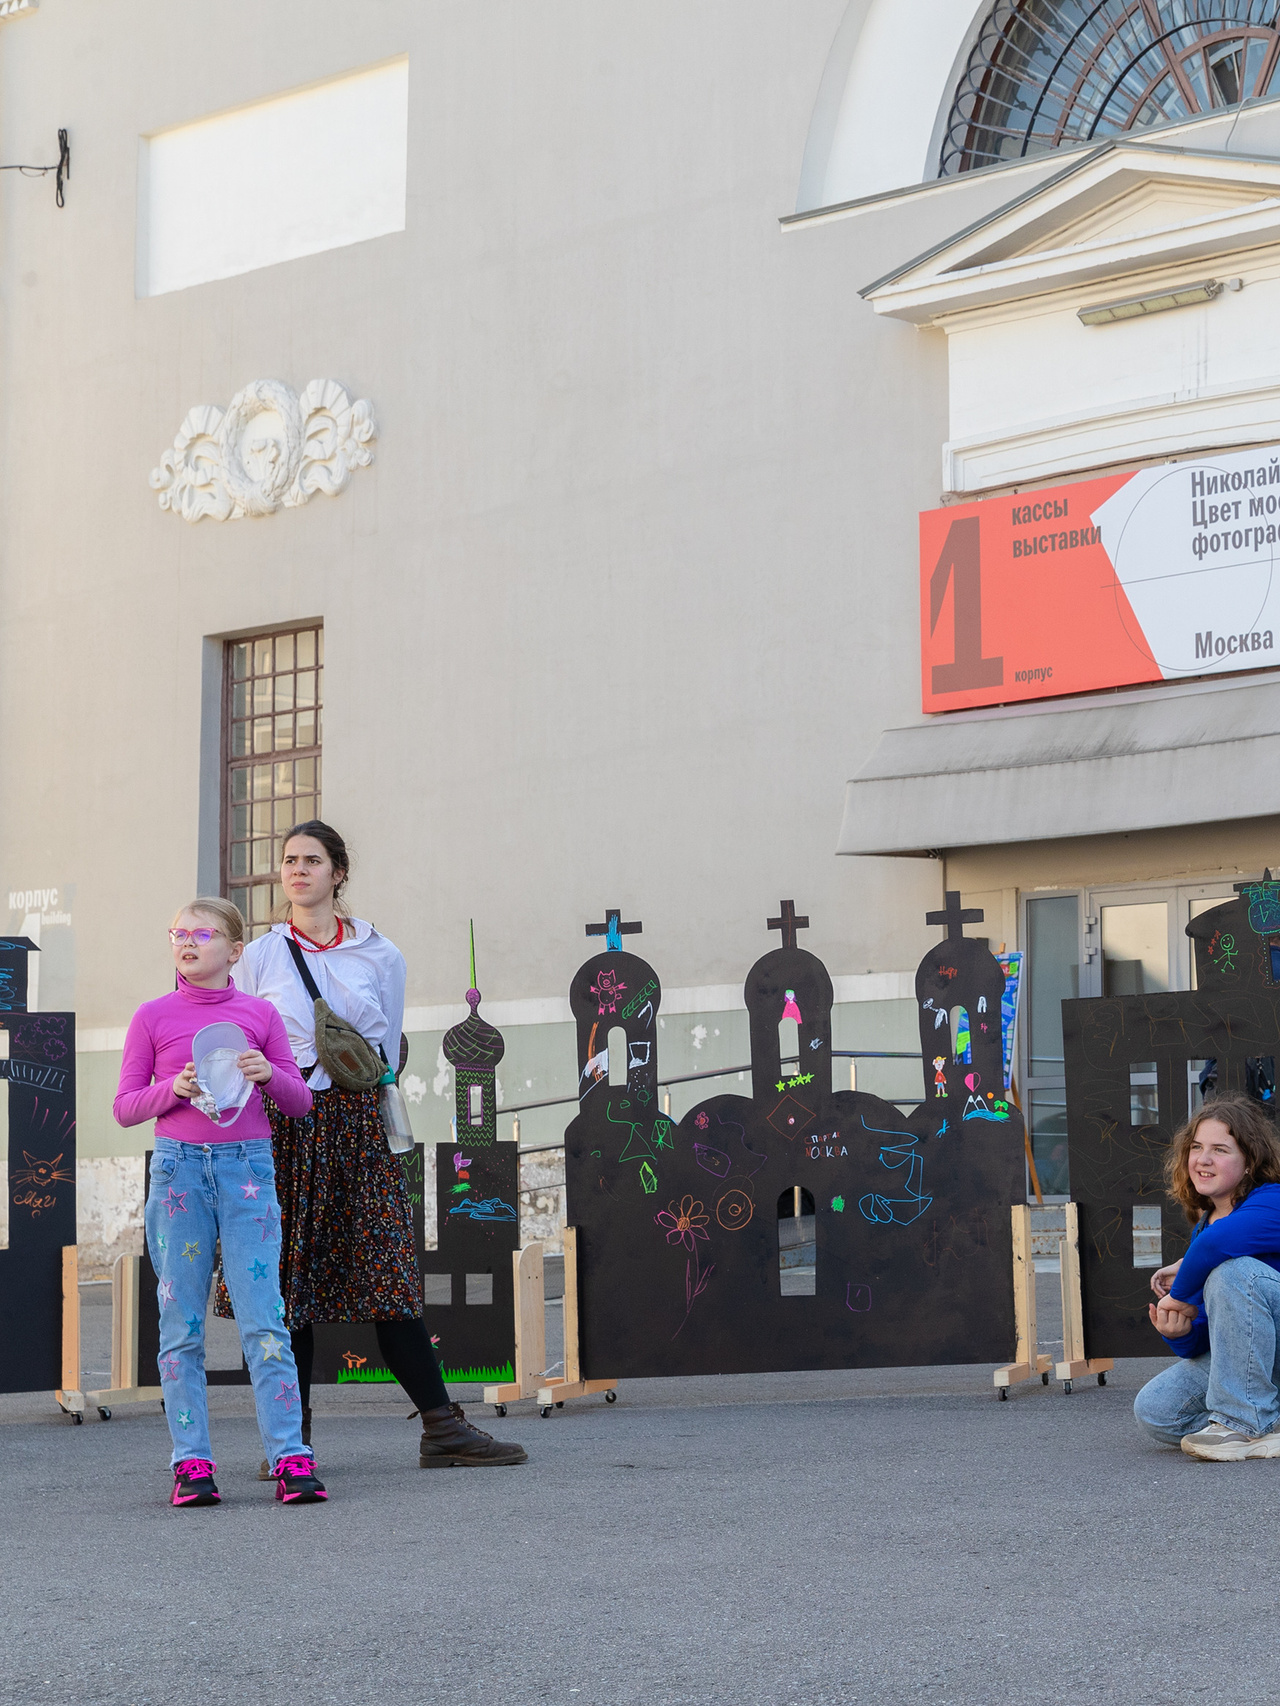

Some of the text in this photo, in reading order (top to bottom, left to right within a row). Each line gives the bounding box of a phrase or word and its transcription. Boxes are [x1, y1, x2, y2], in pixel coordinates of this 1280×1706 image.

[1191, 457, 1280, 498] Николай
[1012, 499, 1068, 526] кассы
[1192, 498, 1242, 529] Цвет
[1013, 526, 1102, 558] выставки
[930, 516, 1003, 695] 1
[1195, 631, 1273, 659] Москва
[1015, 667, 1053, 684] корпус
[9, 888, 58, 914] корпус
[41, 911, 72, 926] building
